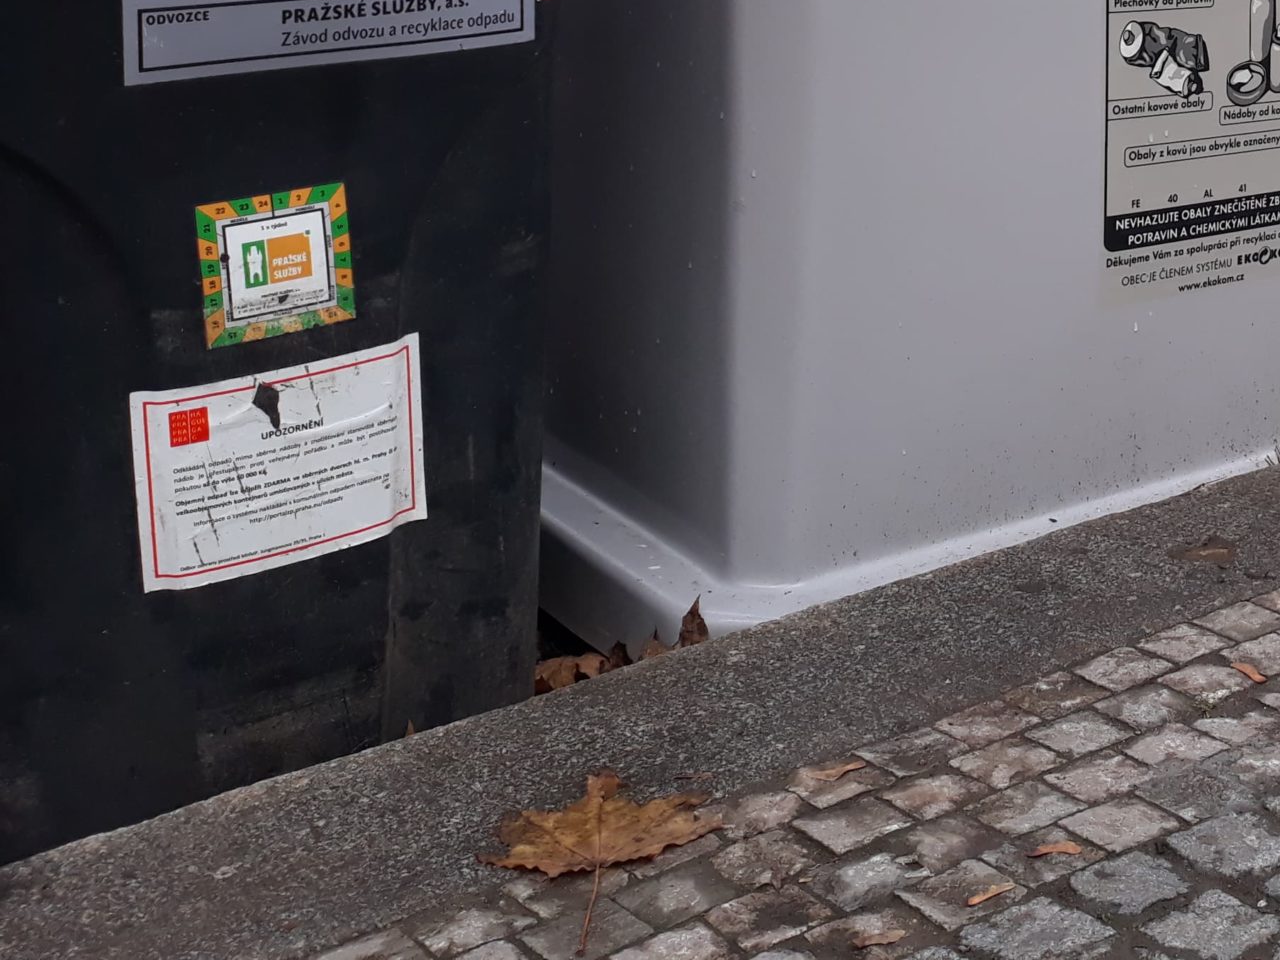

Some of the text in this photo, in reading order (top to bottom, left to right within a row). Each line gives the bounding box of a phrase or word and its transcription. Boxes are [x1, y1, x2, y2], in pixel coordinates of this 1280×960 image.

[146, 10, 210, 25] ODVOZCE
[281, 0, 366, 25] PRAŽSKÉ
[281, 9, 515, 47] Závod odvozu a recyklace odpadu
[1112, 98, 1205, 115] Ostatní kovové obaly
[1224, 108, 1257, 121] Nádoby
[1258, 106, 1270, 116] od
[1128, 149, 1157, 162] Obaly
[1166, 145, 1188, 157] kovů
[1189, 144, 1206, 157] jsou
[1208, 139, 1241, 152] obvykle
[1131, 183, 1247, 209] FE 40 AL 41
[1115, 210, 1179, 231] NEVHAZUJTE
[1181, 204, 1212, 221] OBALY
[1214, 195, 1267, 215] ZNEČIŠTĚNÉ
[1128, 229, 1178, 246] POTRAVIN
[1180, 228, 1187, 237] A
[1189, 215, 1248, 236] CHEMICKÝMI
[272, 252, 307, 266] PRAŽSKÉ
[1106, 254, 1150, 269] Děkujeme
[1152, 248, 1171, 261] Vám
[1173, 247, 1184, 257] za
[1186, 238, 1228, 256] spolupráci
[1229, 235, 1241, 251] při
[1242, 230, 1276, 246] recyklaci
[274, 267, 302, 279] SLUŽBY
[1121, 274, 1148, 287] OBEC
[1148, 272, 1157, 283] JE
[1158, 266, 1193, 281] ČLENEM
[1196, 257, 1233, 273] SYSTÉMU
[1178, 273, 1245, 293] www.ekokom.cz
[261, 417, 324, 440] UPOZORNĚNÍ
